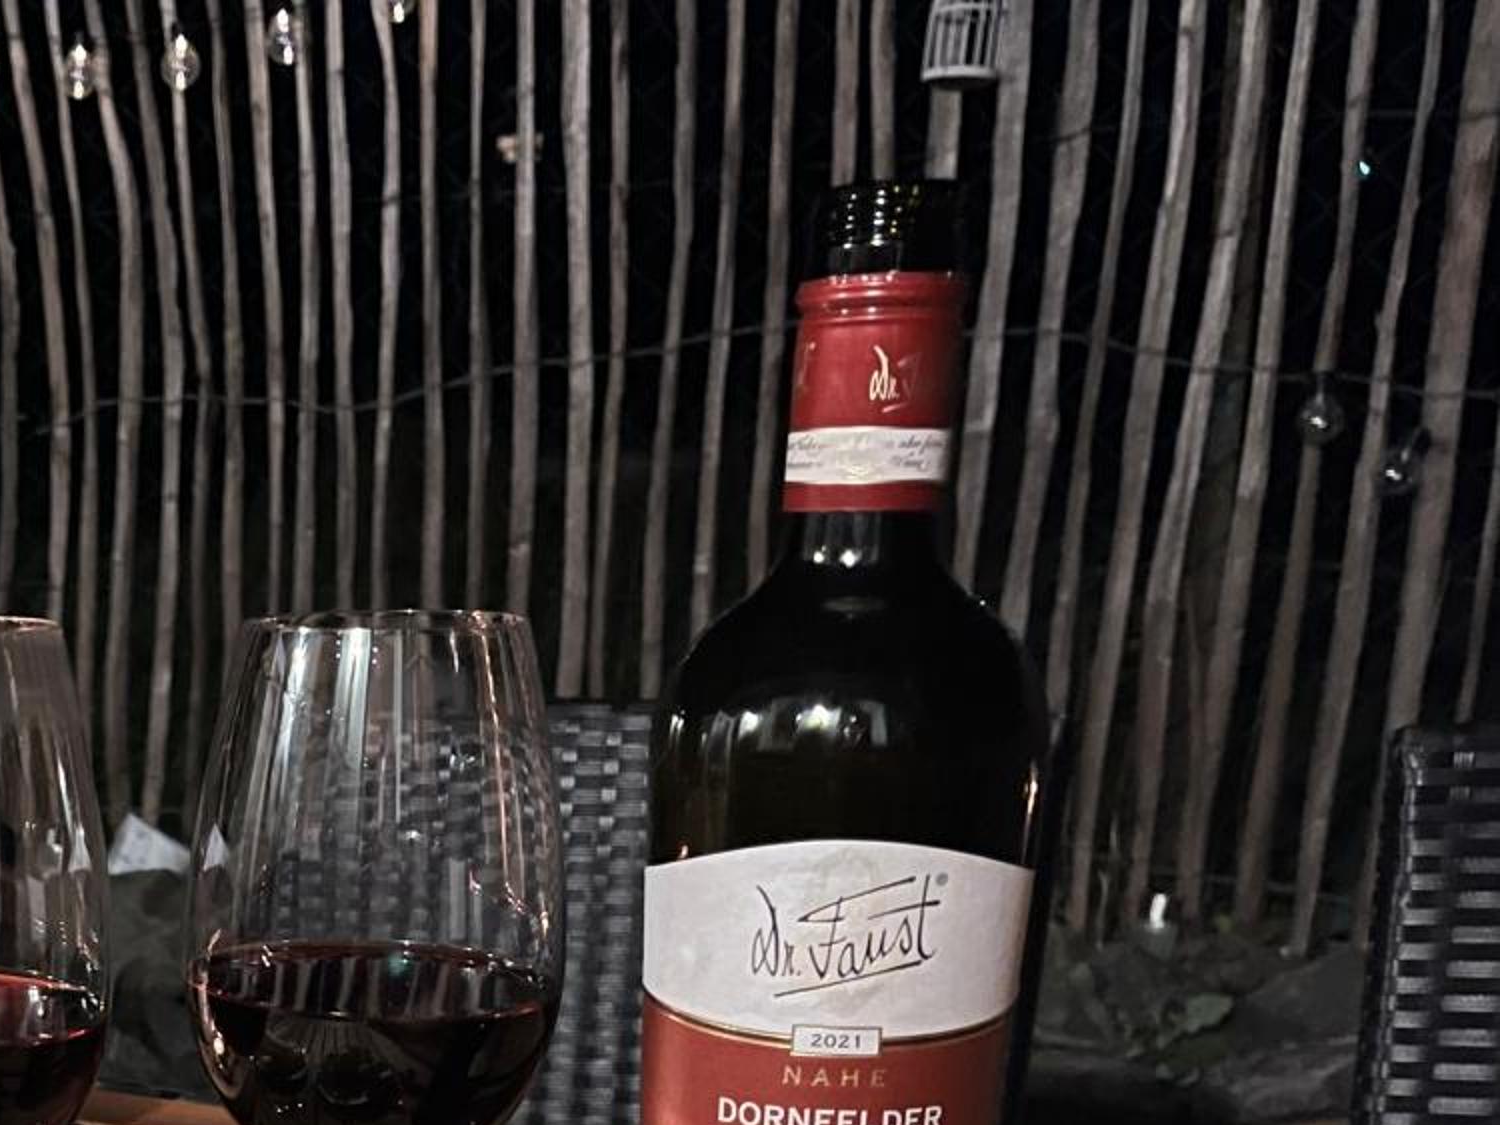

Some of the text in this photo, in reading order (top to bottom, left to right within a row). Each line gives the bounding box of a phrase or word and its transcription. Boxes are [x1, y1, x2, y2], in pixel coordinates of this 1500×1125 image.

[752, 873, 941, 979] Dr. Faust
[810, 1033, 861, 1049] 2021
[781, 1064, 887, 1088] NAHE
